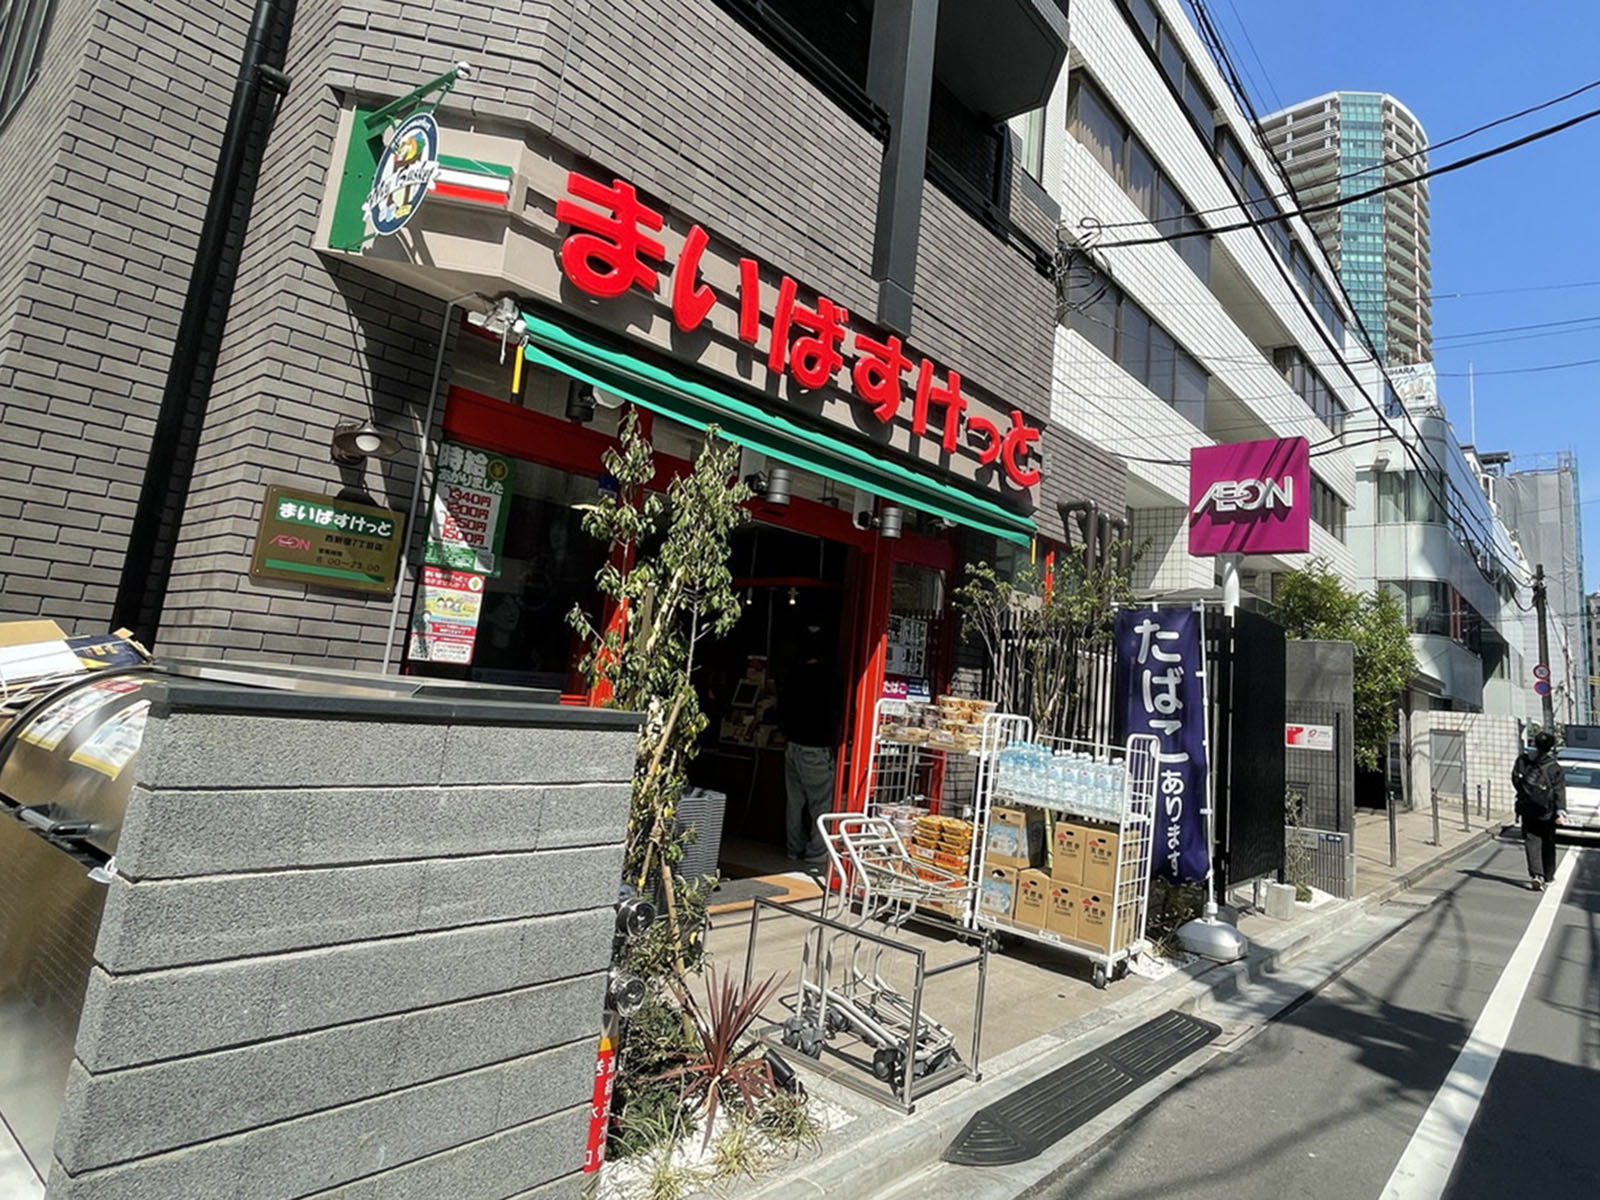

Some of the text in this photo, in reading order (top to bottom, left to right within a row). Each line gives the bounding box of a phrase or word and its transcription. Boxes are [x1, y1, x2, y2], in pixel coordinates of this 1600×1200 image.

[556, 171, 1040, 488] まいばすけっと
[437, 444, 488, 477] 時給
[437, 468, 504, 495] あがりました
[1192, 476, 1293, 513] AEON
[279, 502, 392, 537] まいばすけっと
[269, 534, 311, 550] AEON
[882, 680, 908, 695] たばこ
